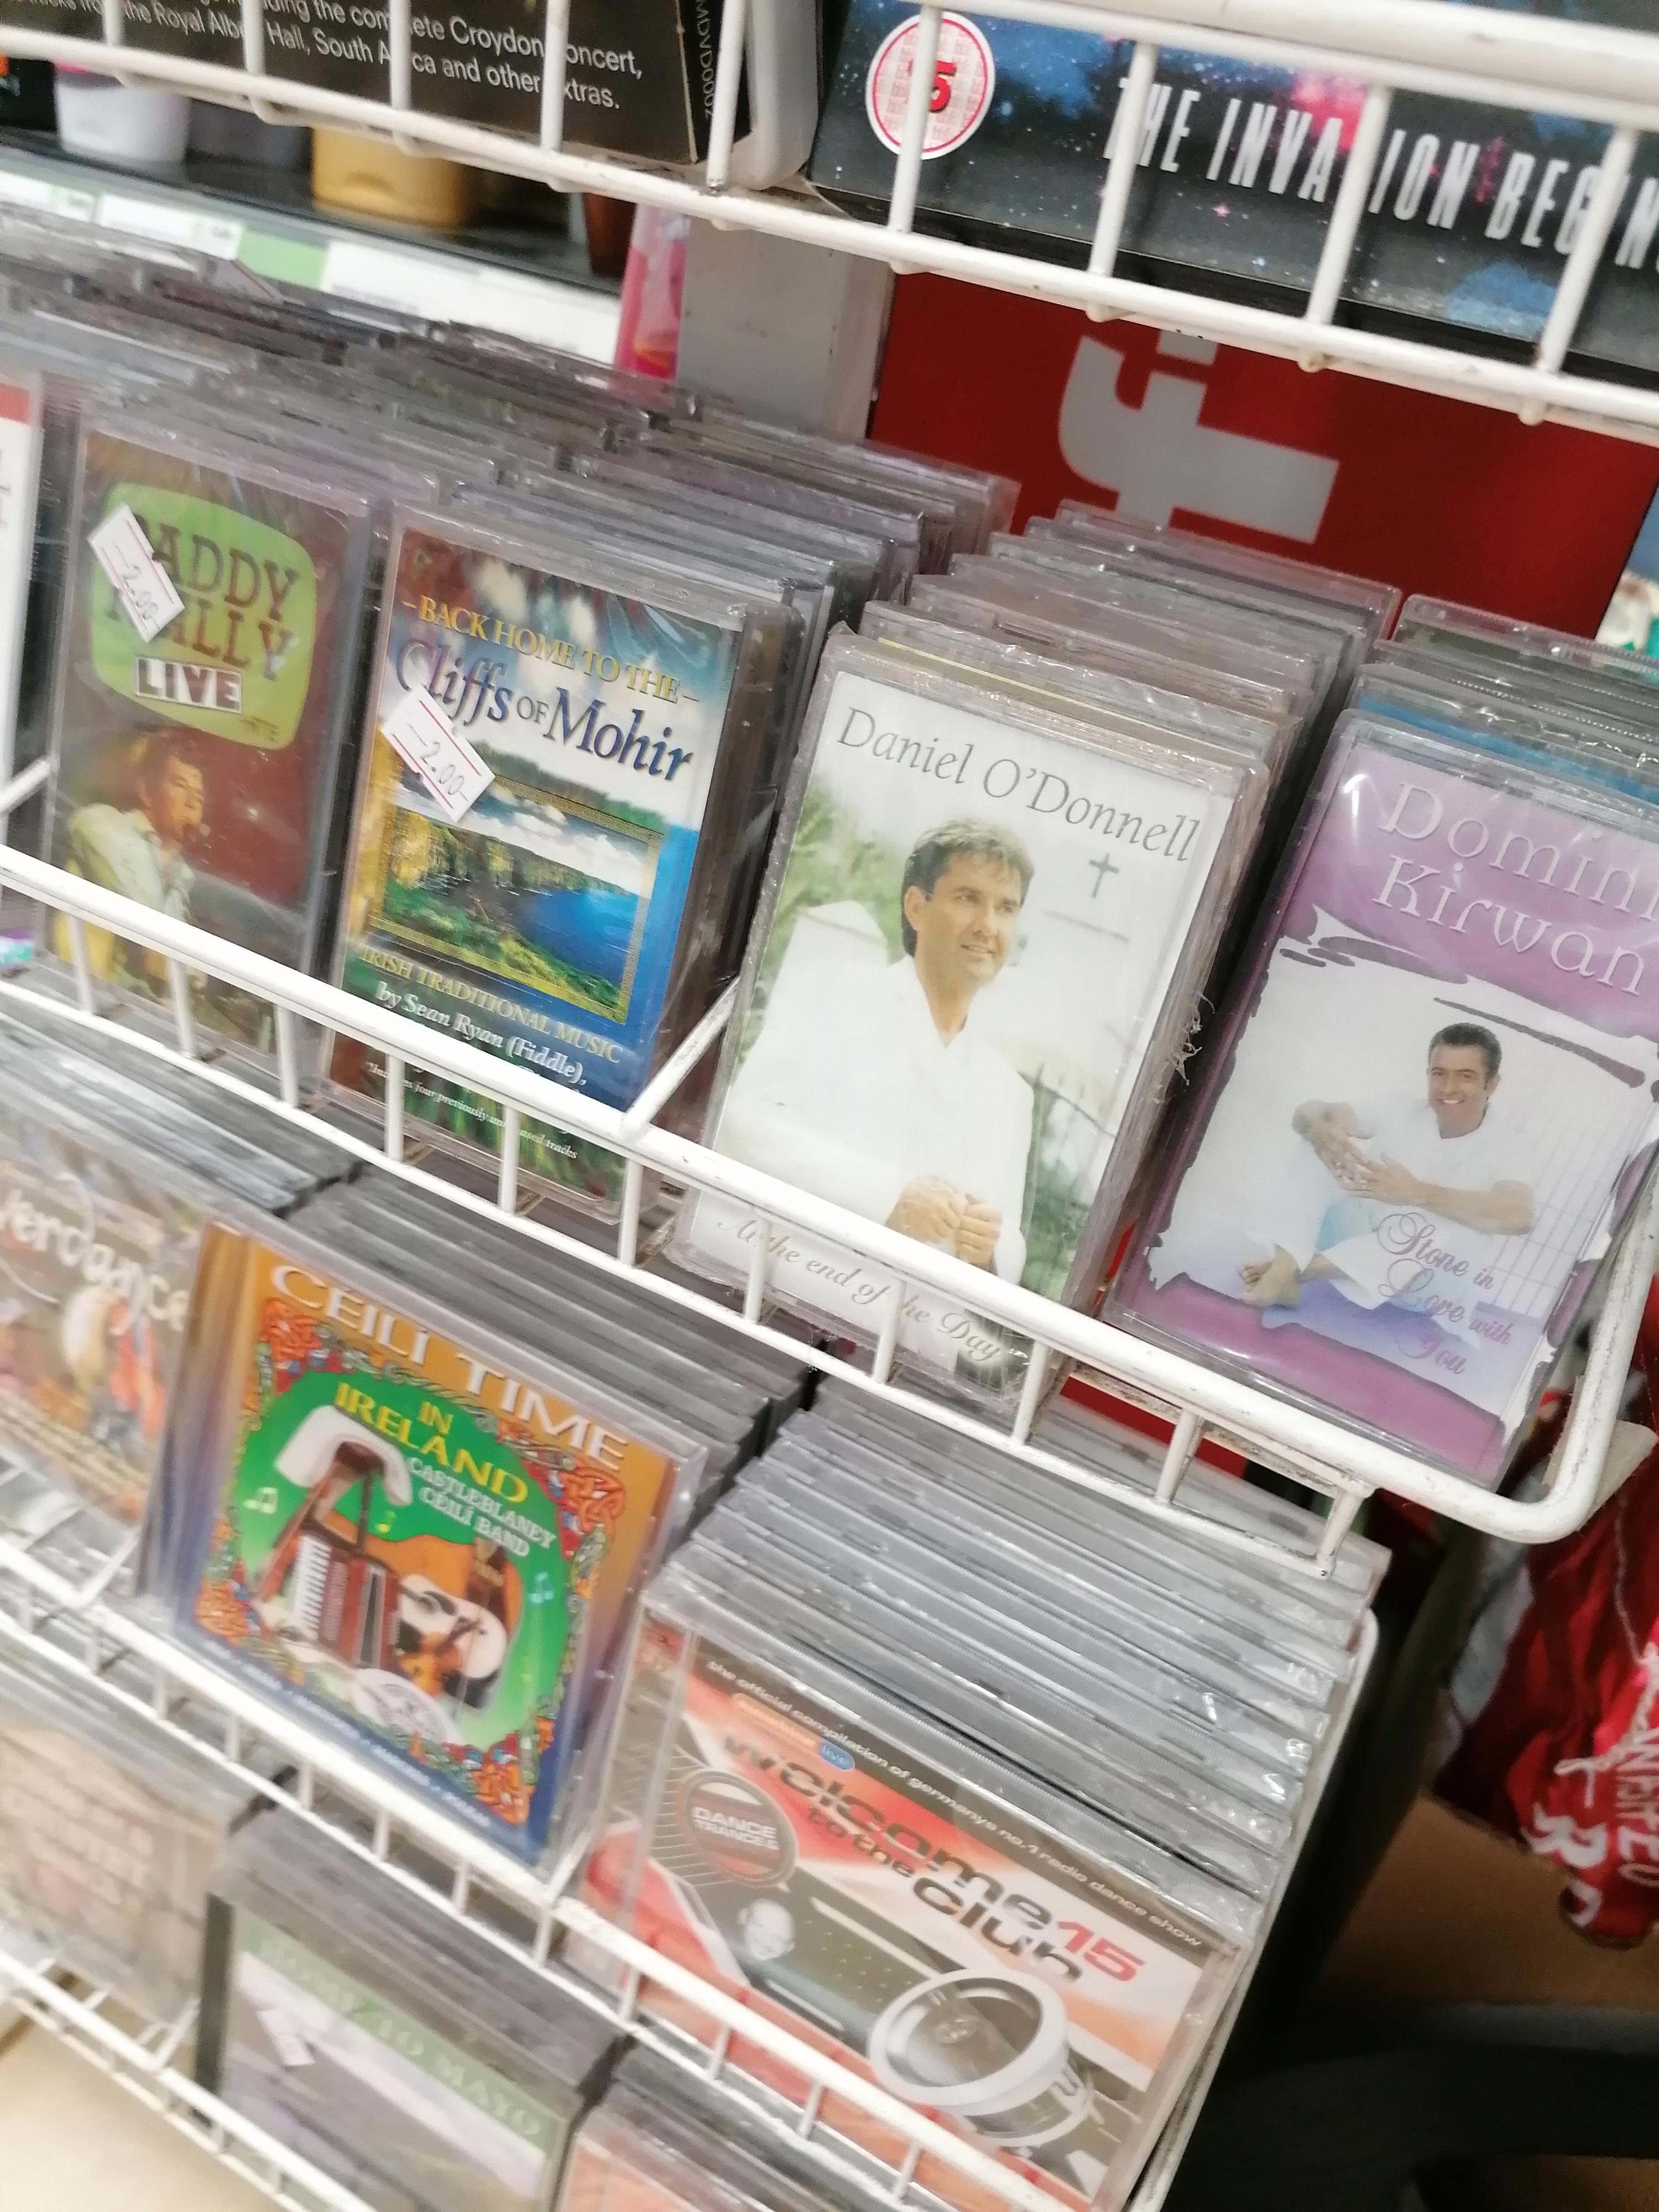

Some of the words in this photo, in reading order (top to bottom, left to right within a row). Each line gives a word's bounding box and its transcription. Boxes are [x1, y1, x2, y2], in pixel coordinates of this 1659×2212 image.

[123, 0, 152, 24] the
[153, 1, 205, 36] Royal
[265, 20, 311, 55] Hall,
[313, 27, 374, 63] South
[377, 39, 437, 75] Aca
[442, 57, 481, 83] and
[486, 62, 541, 93] other
[564, 79, 620, 109] xtras.
[315, 0, 346, 24] the
[349, 6, 445, 40] comete
[449, 15, 545, 58] Croydon
[565, 43, 643, 80] oncert,
[1103, 76, 1200, 174] THE
[1207, 98, 1481, 230] INVAION
[1484, 152, 1659, 271] BEGN
[137, 658, 240, 710] LIVE
[420, 595, 489, 641] BACK
[492, 623, 577, 670] HOME
[581, 649, 620, 683] TO
[624, 664, 680, 704] THE
[396, 640, 514, 727] Cliffs
[517, 695, 550, 727] OF
[542, 687, 695, 782] Mohir
[837, 707, 975, 786] Daniel
[1377, 782, 1659, 925] Domini
[1371, 854, 1646, 997] Kirwan
[360, 946, 413, 980] IRISH
[416, 965, 551, 1034] TRADITIONAL
[552, 1022, 624, 1064] MUSIC
[374, 980, 402, 1010] by
[400, 993, 451, 1027] Sean
[452, 1011, 505, 1050] Ryan
[504, 1035, 588, 1087] (Fiddle),
[1376, 1212, 1469, 1277] Stone
[1473, 1269, 1495, 1290] in
[1378, 1259, 1465, 1322] Love
[1469, 1316, 1513, 1345] with
[806, 1256, 863, 1288] end
[856, 1284, 892, 1307] of
[937, 1310, 1004, 1363] Day
[334, 1381, 529, 1504] IRELAND
[417, 1400, 455, 1434] IN
[455, 1352, 630, 1473] TIME
[474, 1515, 531, 1557] BAND
[691, 1806, 778, 1840] DANCE
[707, 1660, 737, 1681] the
[735, 1679, 793, 1712] official
[791, 1710, 889, 1766] compilation
[887, 1765, 911, 1778] of
[907, 1776, 998, 1832] germanys
[1037, 1853, 1088, 1882] radio
[1088, 1880, 1148, 1917] dance
[1147, 1914, 1202, 1948] show
[852, 1832, 917, 1879] the
[1056, 1921, 1147, 1983] 15
